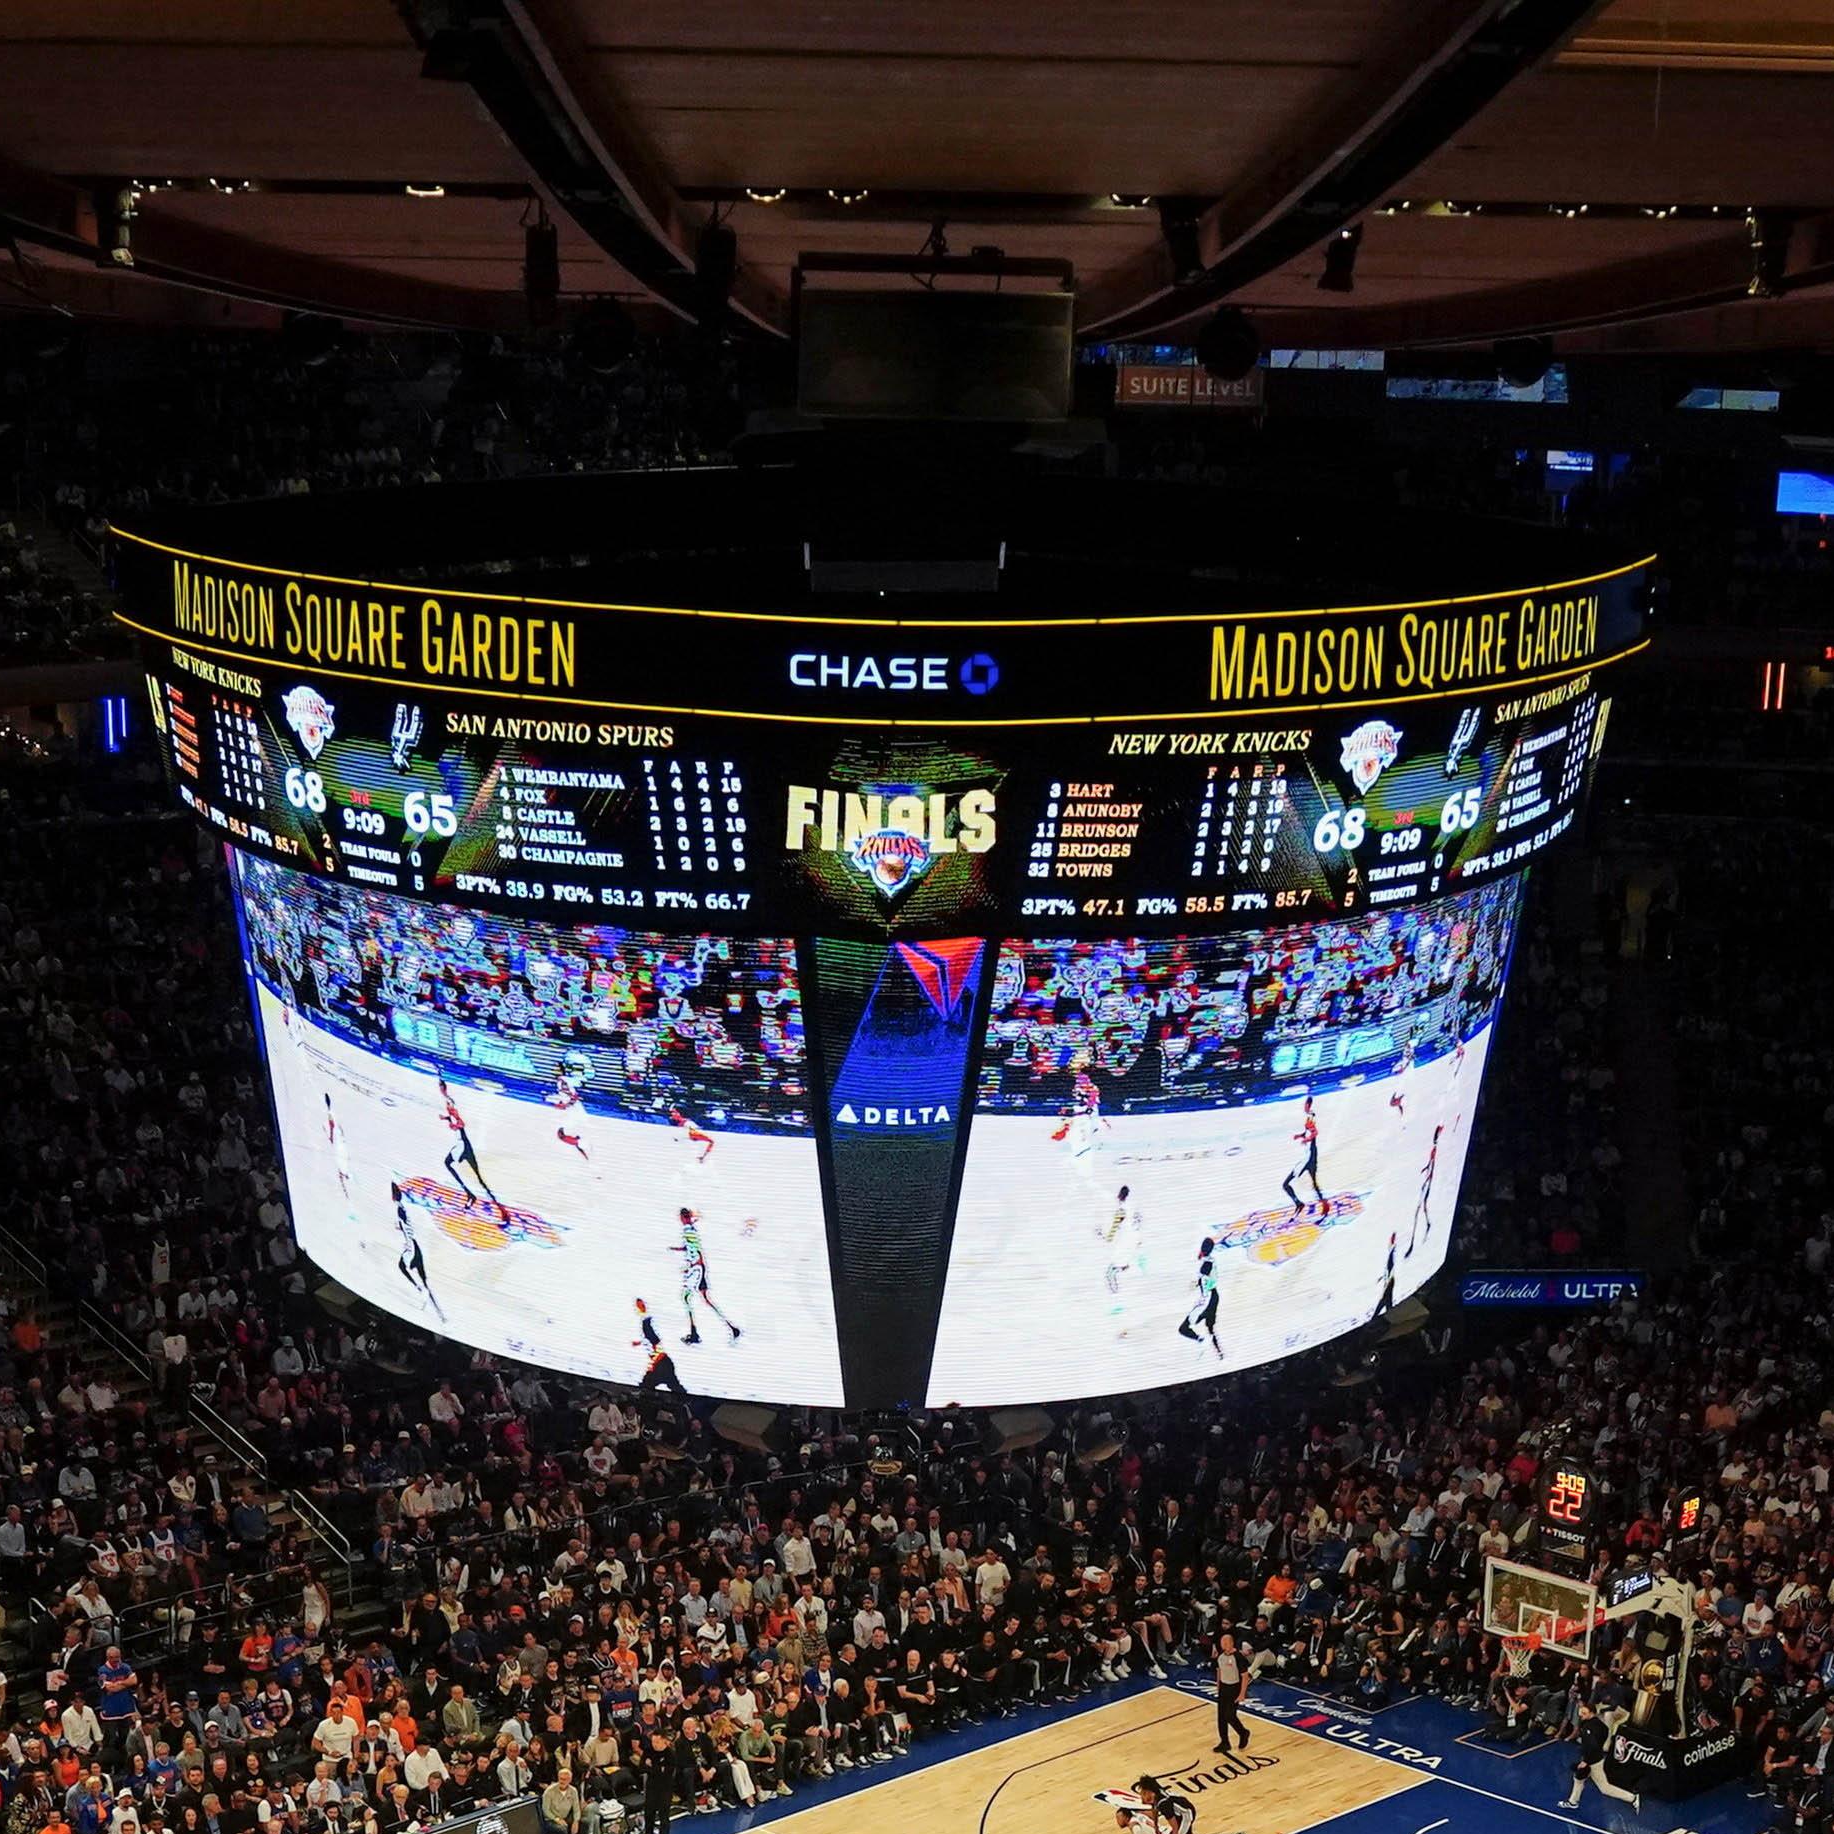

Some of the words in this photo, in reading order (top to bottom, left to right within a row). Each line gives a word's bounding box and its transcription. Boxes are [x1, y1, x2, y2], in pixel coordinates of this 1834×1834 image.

[1129, 375, 1188, 397] SUITE
[173, 559, 275, 650] MADISON
[285, 581, 407, 670] SQUARE
[421, 598, 575, 688] GARDEN
[1209, 624, 1385, 701] MADISON
[1395, 611, 1512, 689] SQUARE
[1516, 594, 1599, 671] GARDEN
[171, 646, 190, 672] NEW
[190, 654, 217, 684] YORK
[218, 666, 262, 699] KNICKS
[789, 653, 950, 690] CHASE
[1494, 699, 1521, 725] SAN
[445, 711, 487, 734] SAN
[491, 717, 592, 743] ANTONIO
[597, 724, 675, 748] SPURS
[1107, 733, 1165, 755] NEW
[1167, 733, 1230, 755] YORK
[1230, 729, 1313, 754] KNICKS
[284, 766, 327, 813] 68
[510, 767, 626, 791] WEMBANYAMA
[1066, 783, 1114, 798] HART
[514, 787, 548, 805] FOX
[342, 807, 386, 836] 9:09
[403, 791, 458, 837] 65
[516, 807, 576, 827] CASTLE
[785, 784, 997, 854] FINALS
[1062, 803, 1143, 819] ANUNOBY
[1439, 785, 1484, 834] 65
[495, 824, 515, 841] 24
[517, 826, 587, 847] VASSELL
[1035, 822, 1056, 839] 11
[1059, 823, 1140, 839] BRUNSON
[1312, 807, 1367, 852] 68
[1379, 827, 1422, 855] 9:09
[521, 846, 624, 869] CHAMPAGNIE
[856, 834, 927, 860] KNICKS
[1030, 842, 1053, 859] 25
[1056, 843, 1132, 859] BRIDGES
[1027, 861, 1050, 878] 32
[1054, 862, 1114, 878] TOWNS
[1367, 864, 1397, 883] TEAM
[455, 873, 502, 896] 3PT%
[505, 880, 545, 900] 38.9
[552, 884, 594, 904] FG%
[600, 887, 645, 907] 53.2
[654, 890, 698, 910] FT%
[704, 892, 751, 911] 66.7
[1020, 898, 1077, 916] 3PT%
[1081, 898, 1125, 917] 47.1
[1135, 897, 1178, 916] FG%
[1184, 895, 1226, 913] 58.5
[1230, 893, 1268, 911] FT%
[1273, 889, 1313, 908] 85.7
[863, 1104, 953, 1126] DELTA
[1462, 1280, 1542, 1301] Michelob
[1563, 1282, 1639, 1300] ULTR
[1556, 1471, 1586, 1494] 9:09
[1548, 1486, 1583, 1521] 22
[1680, 1510, 1698, 1529] 22
[1552, 1527, 1587, 1544] TISSOT
[1325, 1723, 1446, 1771] ULTRA
[1626, 1740, 1668, 1769] Finals
[1683, 1732, 1737, 1766] coinbase
